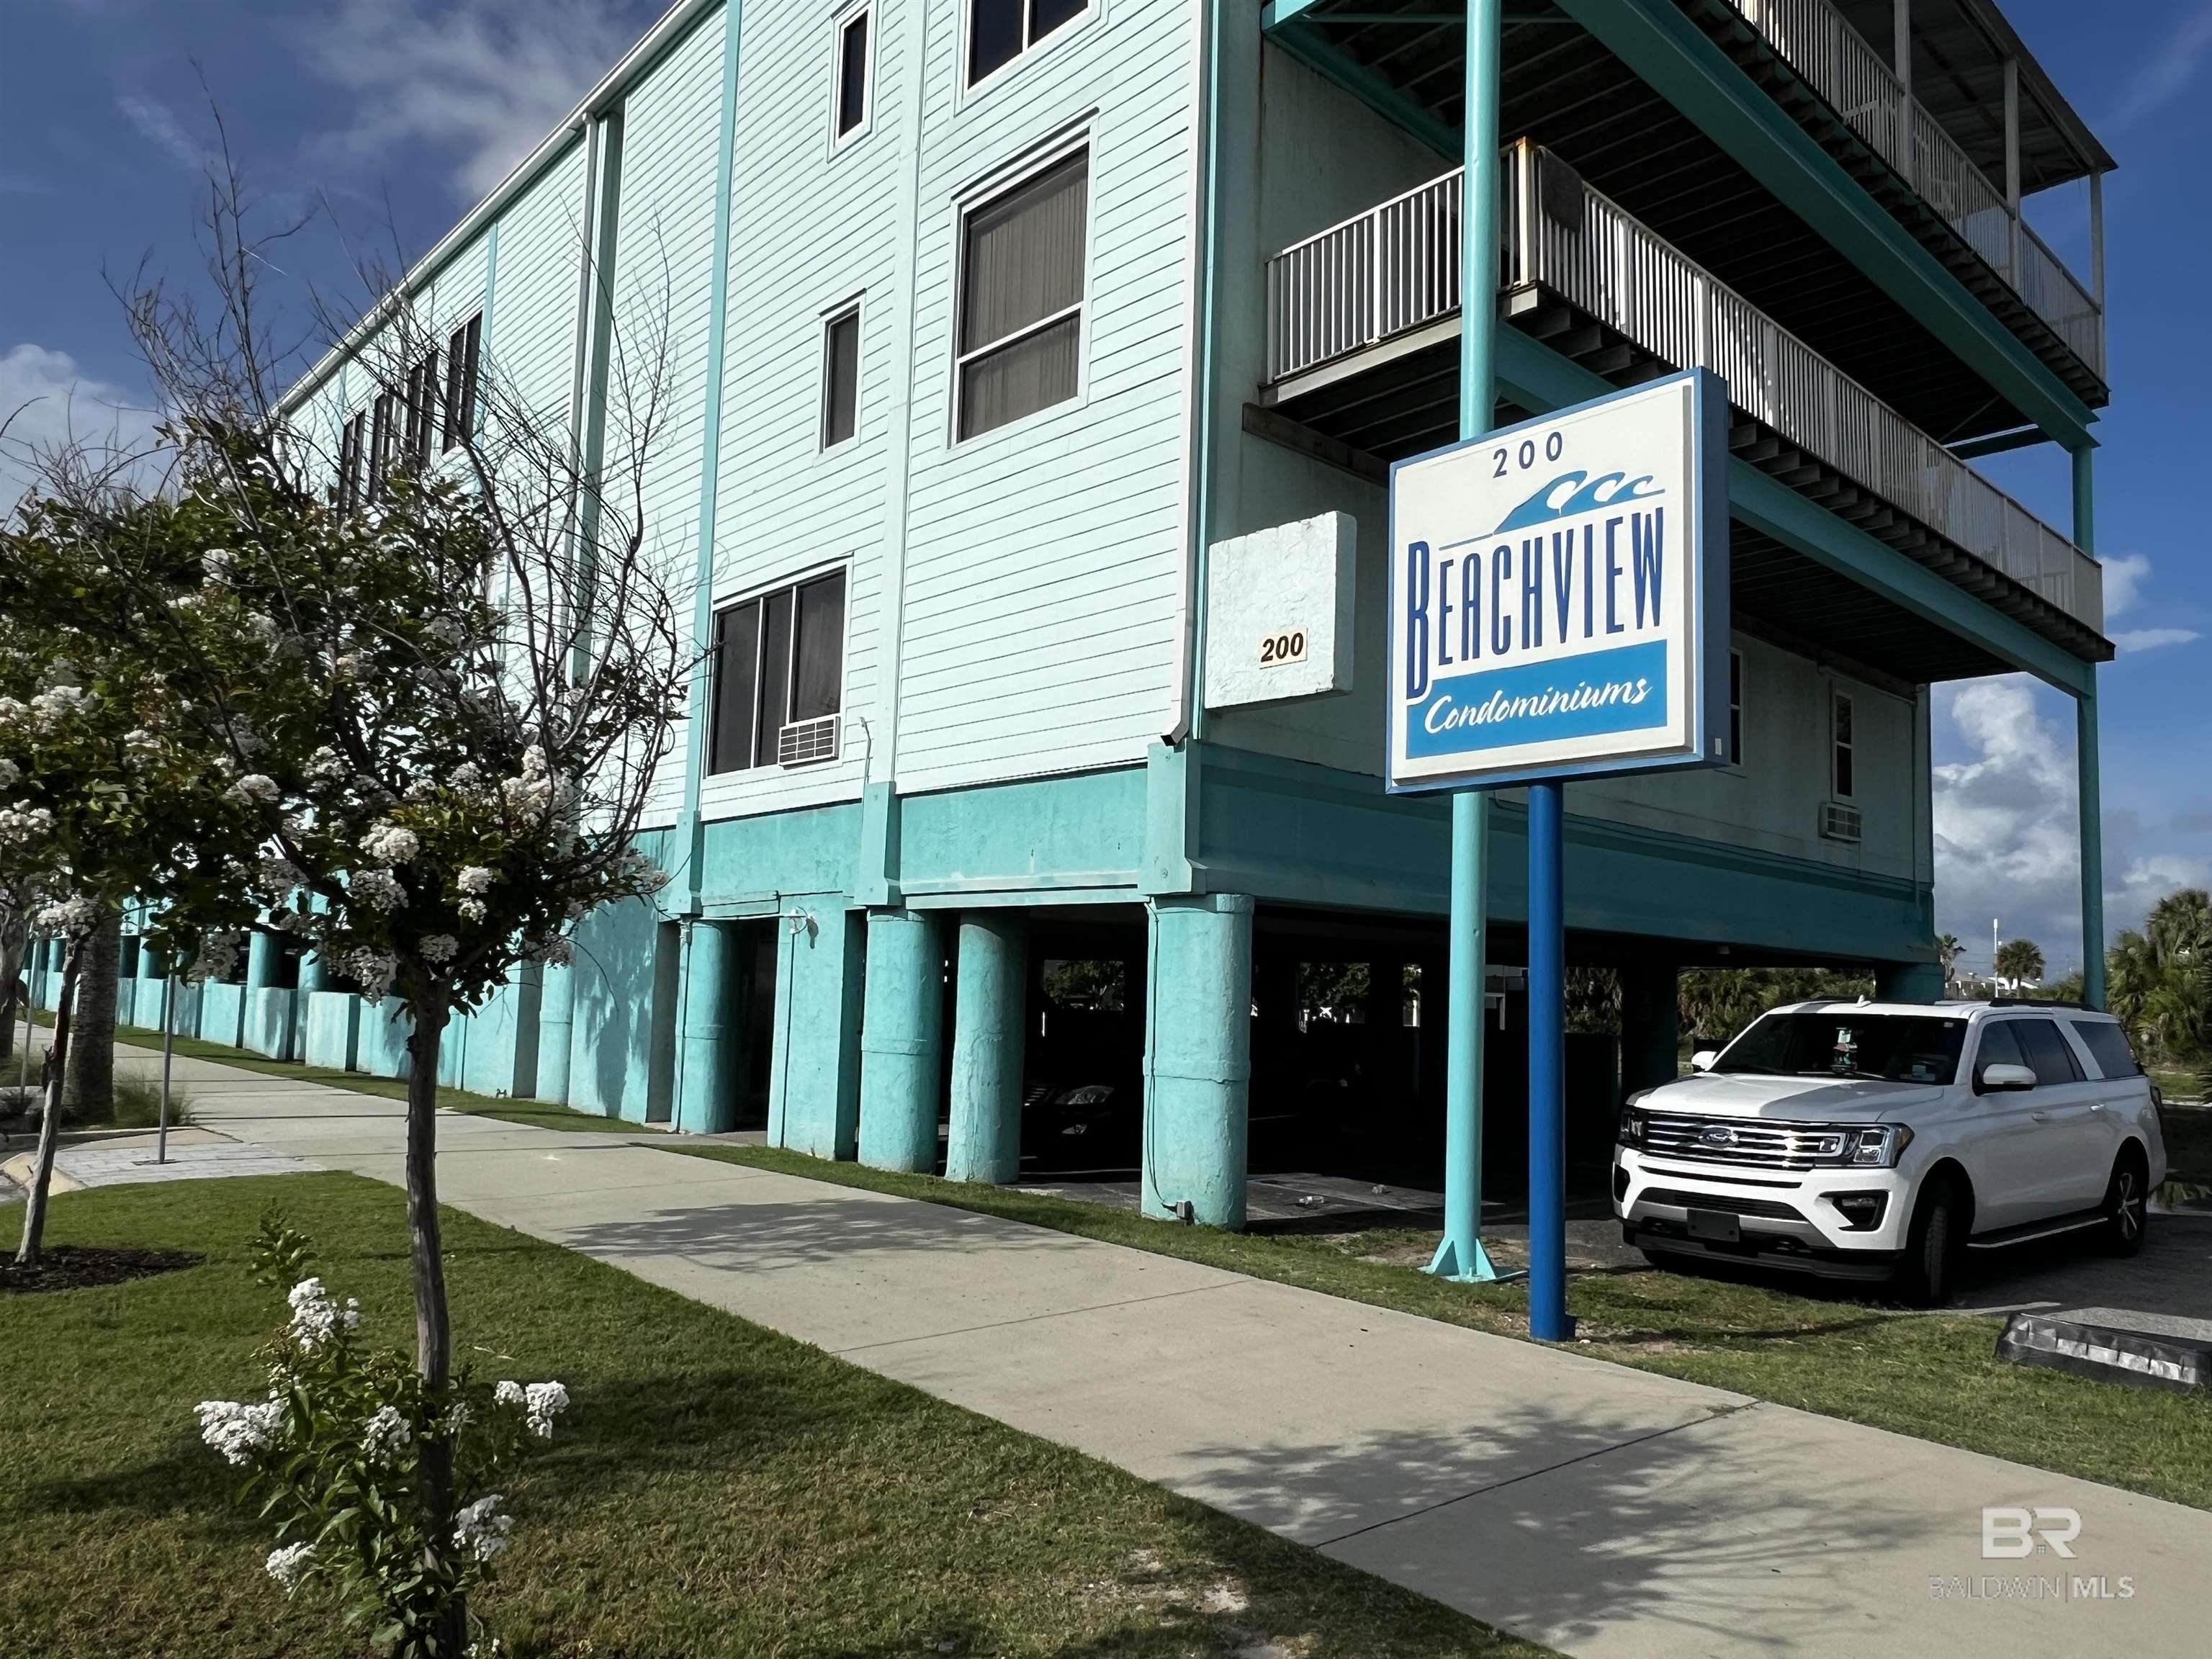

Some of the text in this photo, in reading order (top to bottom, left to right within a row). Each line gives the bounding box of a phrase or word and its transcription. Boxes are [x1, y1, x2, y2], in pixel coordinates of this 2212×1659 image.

[1493, 431, 1563, 478] 200
[1406, 506, 1664, 699] BEACHVIEW
[1260, 632, 1304, 662] 200
[1424, 675, 1653, 734] Condominiums
